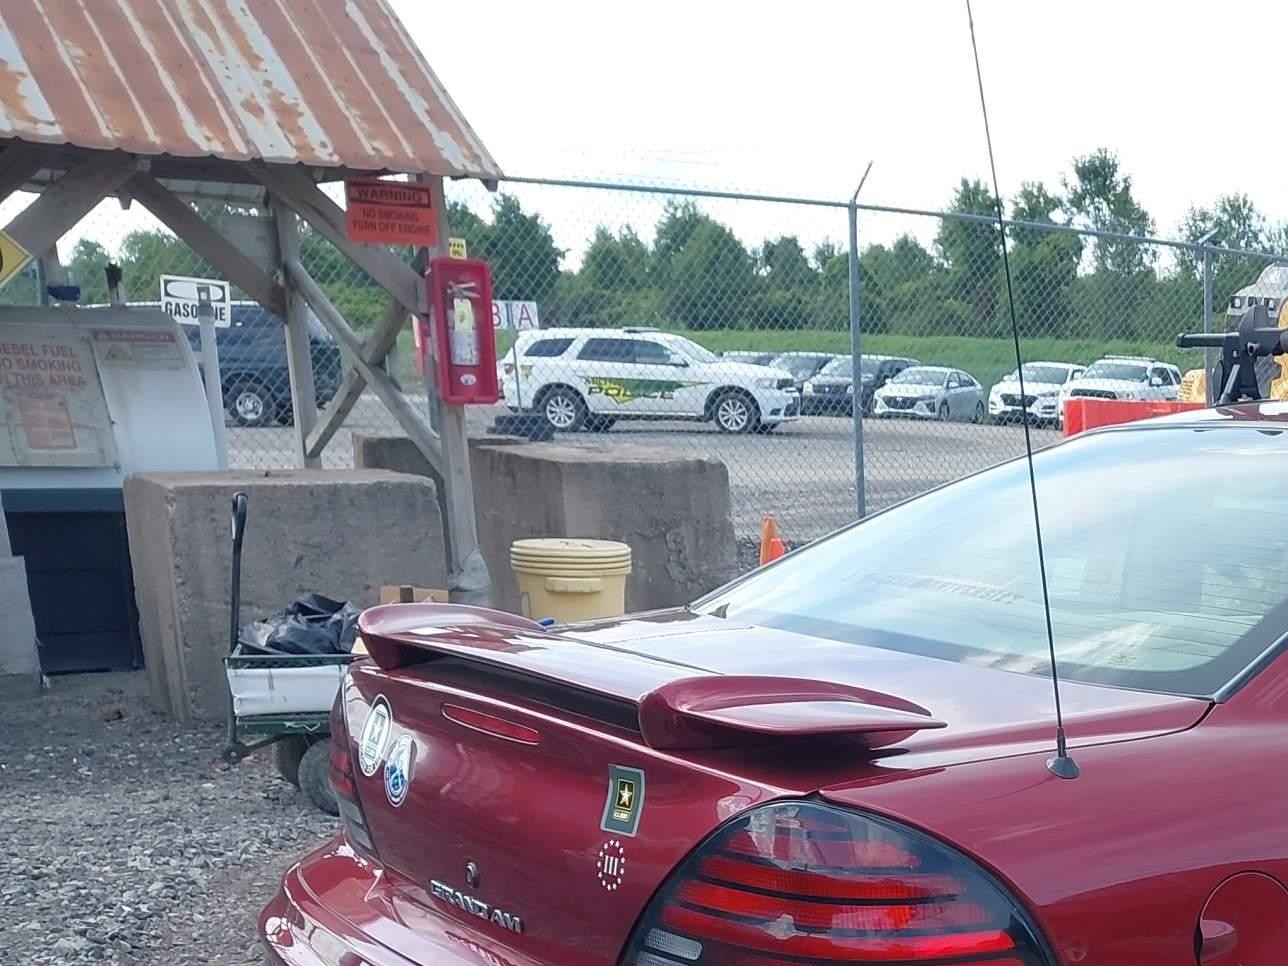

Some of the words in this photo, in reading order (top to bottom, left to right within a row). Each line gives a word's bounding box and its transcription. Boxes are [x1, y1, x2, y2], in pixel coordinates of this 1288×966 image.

[356, 186, 422, 201] WARNING
[363, 208, 376, 219] NO
[378, 209, 419, 221] SMOKING
[353, 219, 377, 231] TURN
[380, 221, 396, 233] OFF
[399, 223, 431, 235] ENGINE
[165, 301, 226, 322] GASONE
[518, 303, 534, 327] A
[0, 342, 39, 357] ESEL
[41, 344, 78, 359] FUEL
[0, 357, 12, 370] O
[17, 358, 82, 371] SMOKING
[11, 372, 44, 386] THIS
[587, 386, 675, 400] POLCE
[429, 879, 489, 919] GRAND
[489, 908, 525, 934] AM
